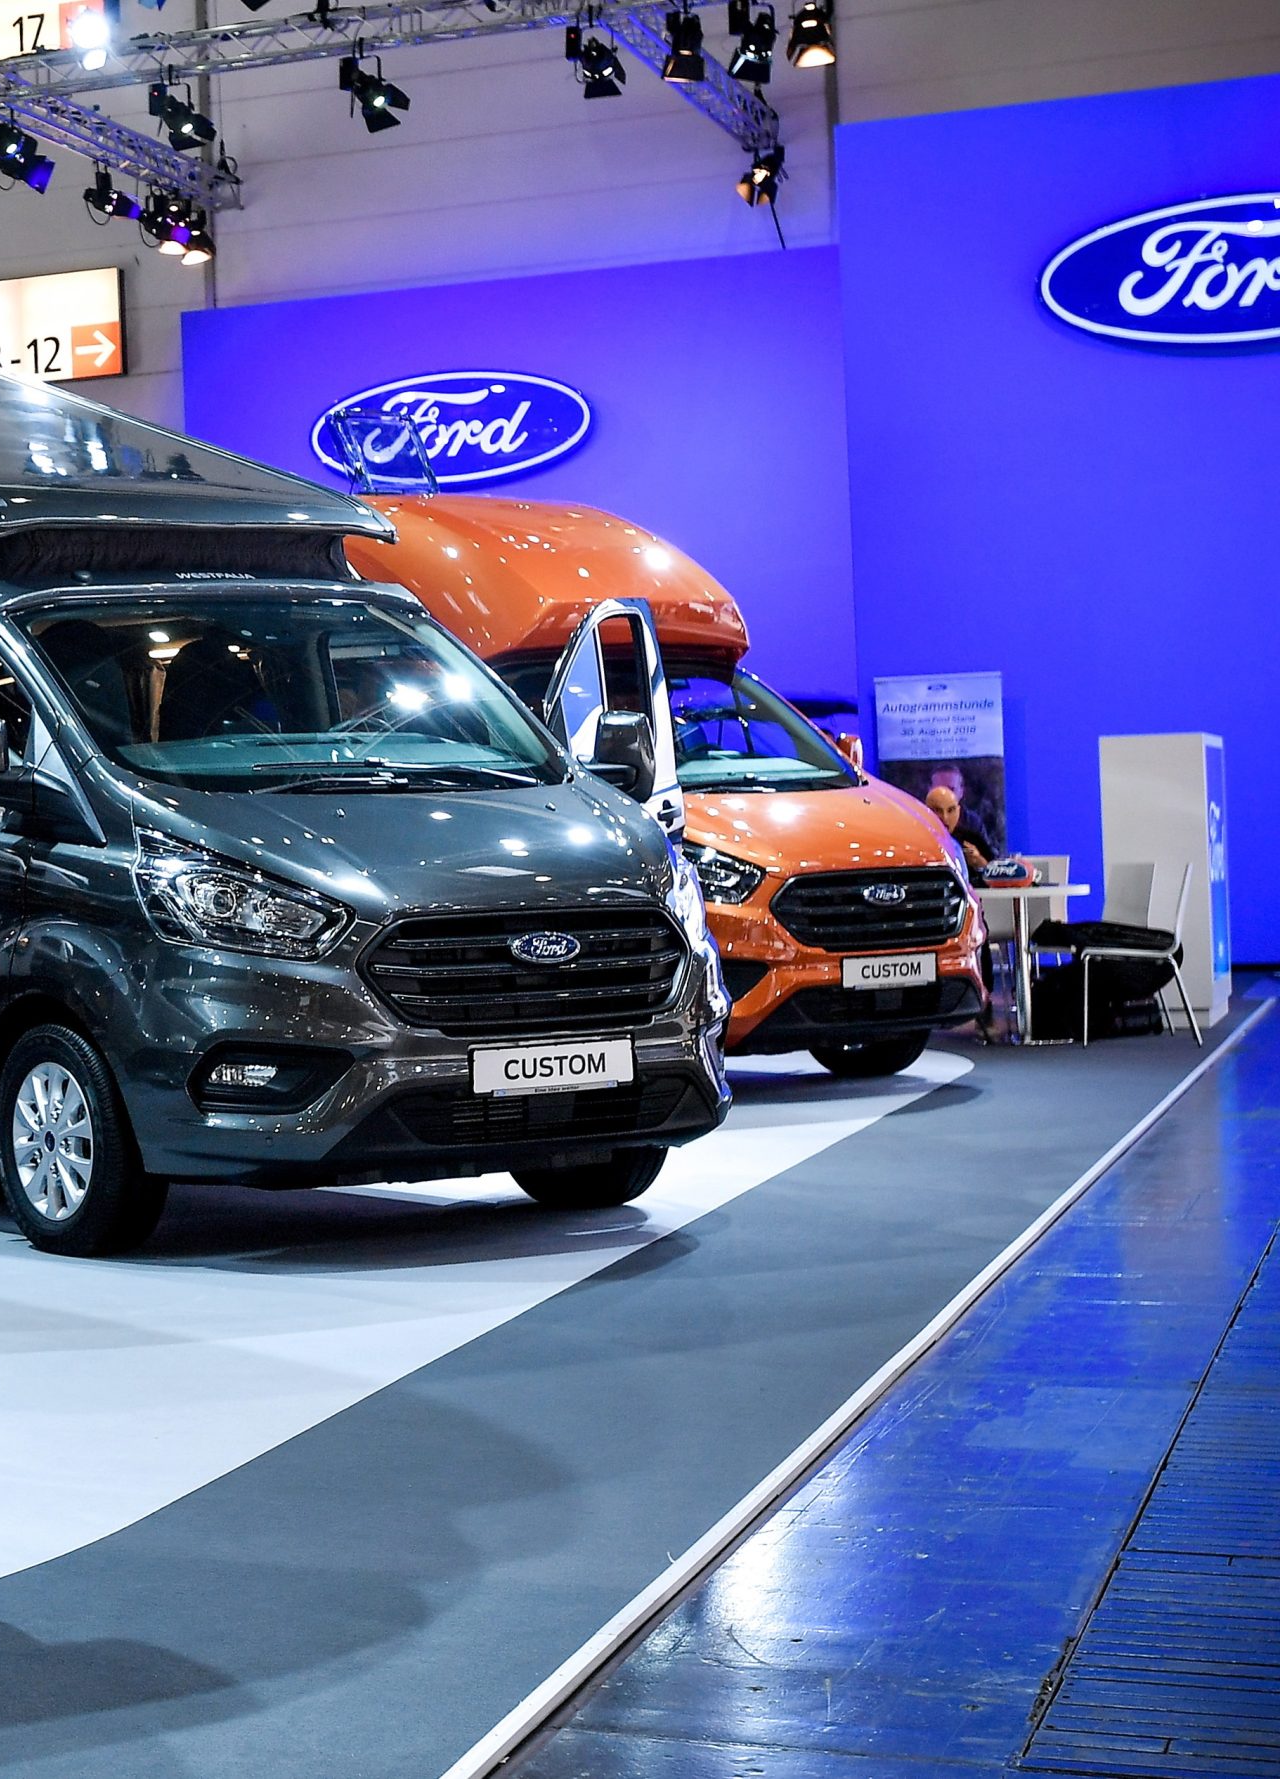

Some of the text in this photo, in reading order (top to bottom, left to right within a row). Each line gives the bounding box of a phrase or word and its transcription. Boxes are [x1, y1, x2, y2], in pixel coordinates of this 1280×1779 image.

[12, 13, 45, 52] 17
[1118, 219, 1280, 317] For
[362, 391, 532, 464] Ford
[881, 698, 995, 714] Autogrammstunde
[984, 859, 1018, 877] Ford
[530, 936, 568, 956] Ford
[861, 961, 921, 979] CUSTOM
[503, 1052, 607, 1081] CUSTOM
